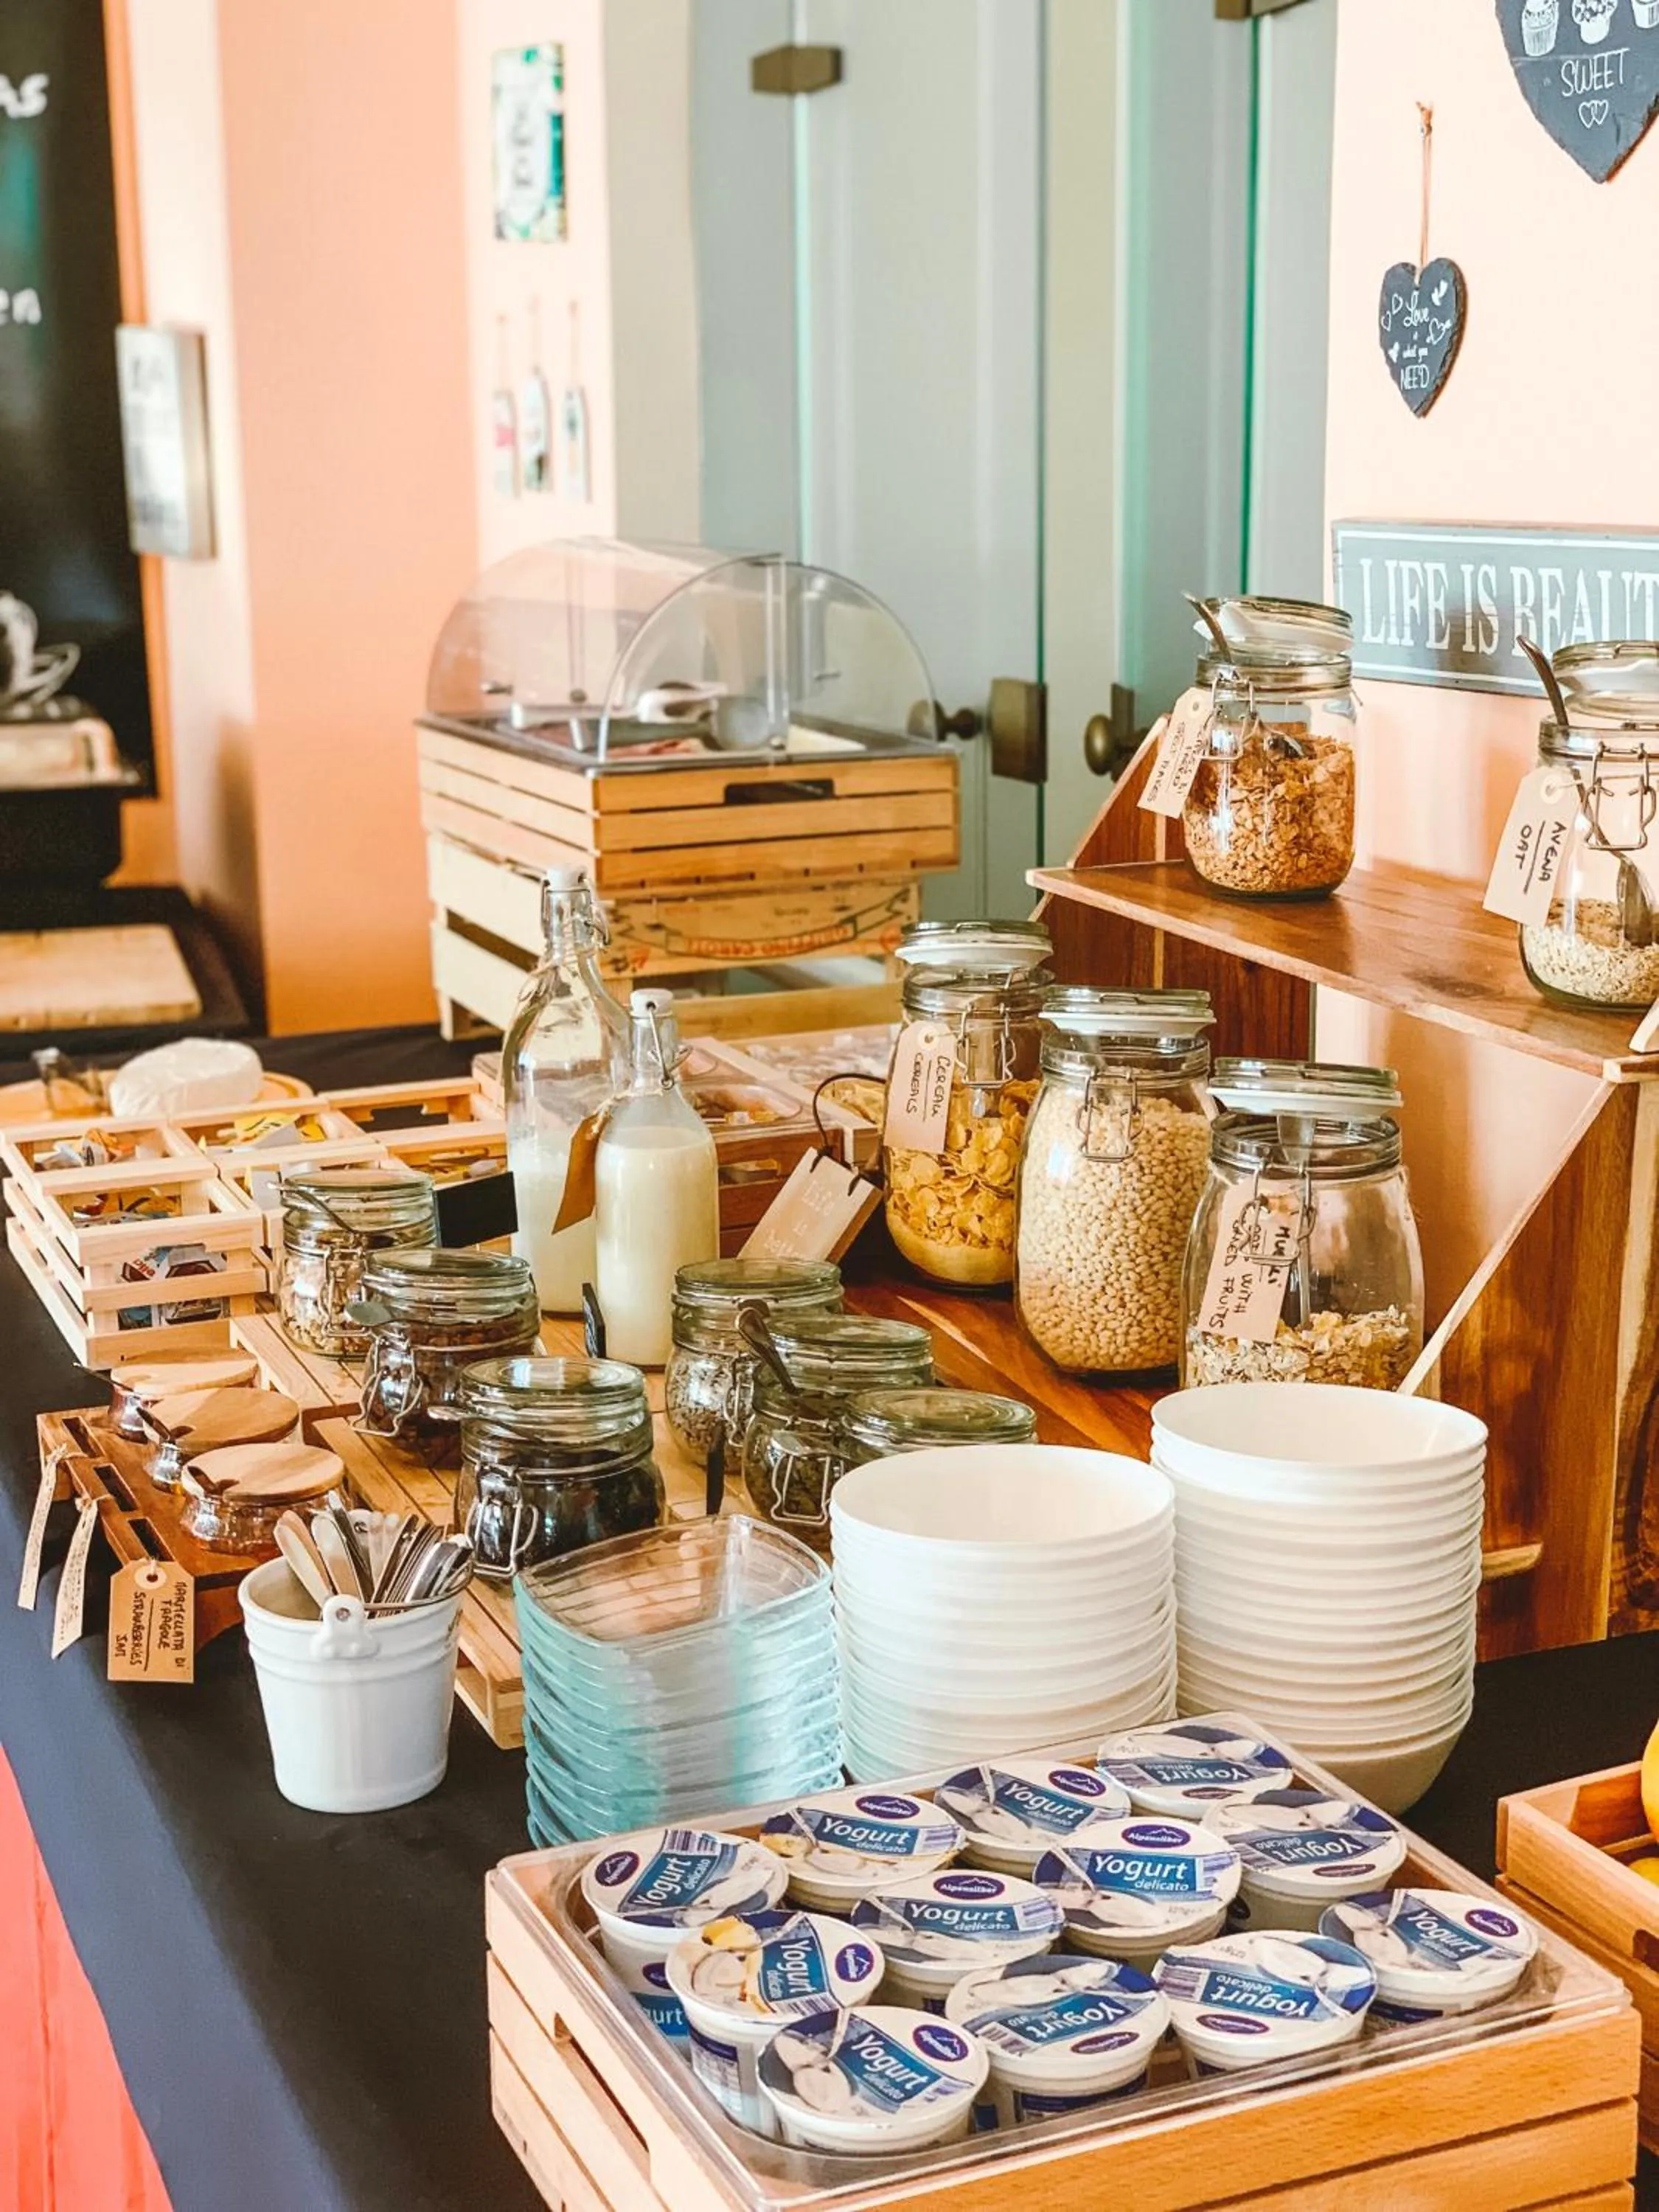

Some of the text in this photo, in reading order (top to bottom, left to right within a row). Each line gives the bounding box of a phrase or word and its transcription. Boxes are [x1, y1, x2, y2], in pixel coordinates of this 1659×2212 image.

[1561, 48, 1630, 98] SWEET
[1404, 290, 1430, 327] Love
[1400, 364, 1430, 391] NEED
[1360, 558, 1450, 650] LIFE
[1460, 564, 1500, 655] IS
[1515, 824, 1532, 870] OAT
[1538, 821, 1568, 882] AVENA
[1208, 1276, 1234, 1328] FRUITS
[1233, 1273, 1253, 1313] WITH
[1158, 1767, 1249, 1781] Yogurt
[1004, 1782, 1085, 1819] Yogurt
[822, 1817, 911, 1845] Yogurt
[1095, 1854, 1187, 1881] Yogurt
[1273, 1838, 1363, 1863] Yogurt
[633, 1857, 692, 1906] Yogurt
[1135, 1880, 1189, 1892] delicato
[910, 1903, 1009, 1925] Yogurt
[954, 1921, 1012, 1931] delicato
[1408, 1910, 1483, 1952] Yogurt
[776, 1940, 817, 1993] Yogurt
[1217, 1974, 1273, 1994] delicato
[1026, 2001, 1126, 2039] Yogurt
[1211, 1986, 1311, 2017] Yogurt
[851, 2034, 929, 2090] Yogurt
